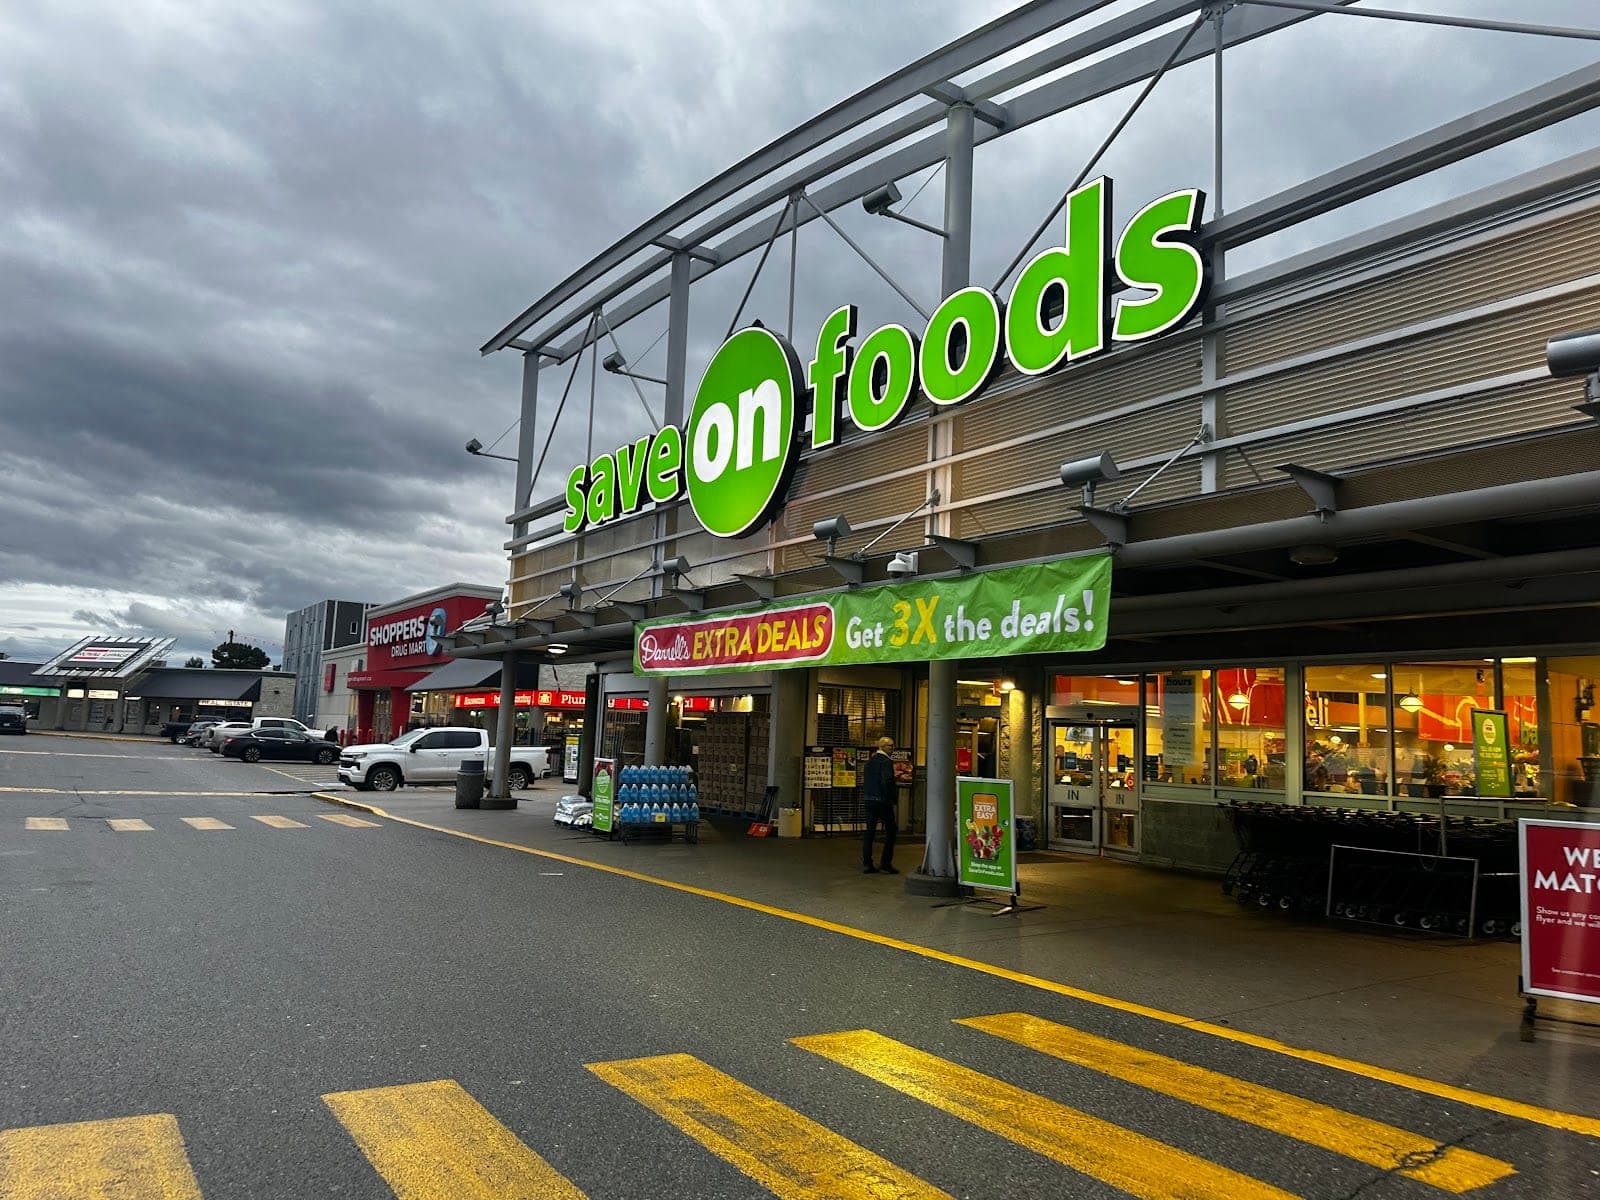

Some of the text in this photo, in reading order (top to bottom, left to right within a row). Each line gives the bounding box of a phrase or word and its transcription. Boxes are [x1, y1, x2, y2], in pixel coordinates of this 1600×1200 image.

[563, 175, 1204, 533] save on foods
[843, 589, 1094, 648] Get 3X the deals!
[369, 615, 426, 647] SHOPPERS
[640, 614, 827, 664] Darrell's EXTRA DEALS
[391, 640, 427, 657] DRUG MART
[1067, 790, 1079, 800] IN
[1115, 793, 1125, 805] IN
[974, 803, 996, 812] EXTRA
[976, 811, 994, 820] EASY
[1534, 869, 1600, 894] MAT
[1536, 905, 1559, 916] Show
[1571, 912, 1587, 921] any
[1536, 914, 1555, 924] flyer
[1557, 918, 1572, 926] and
